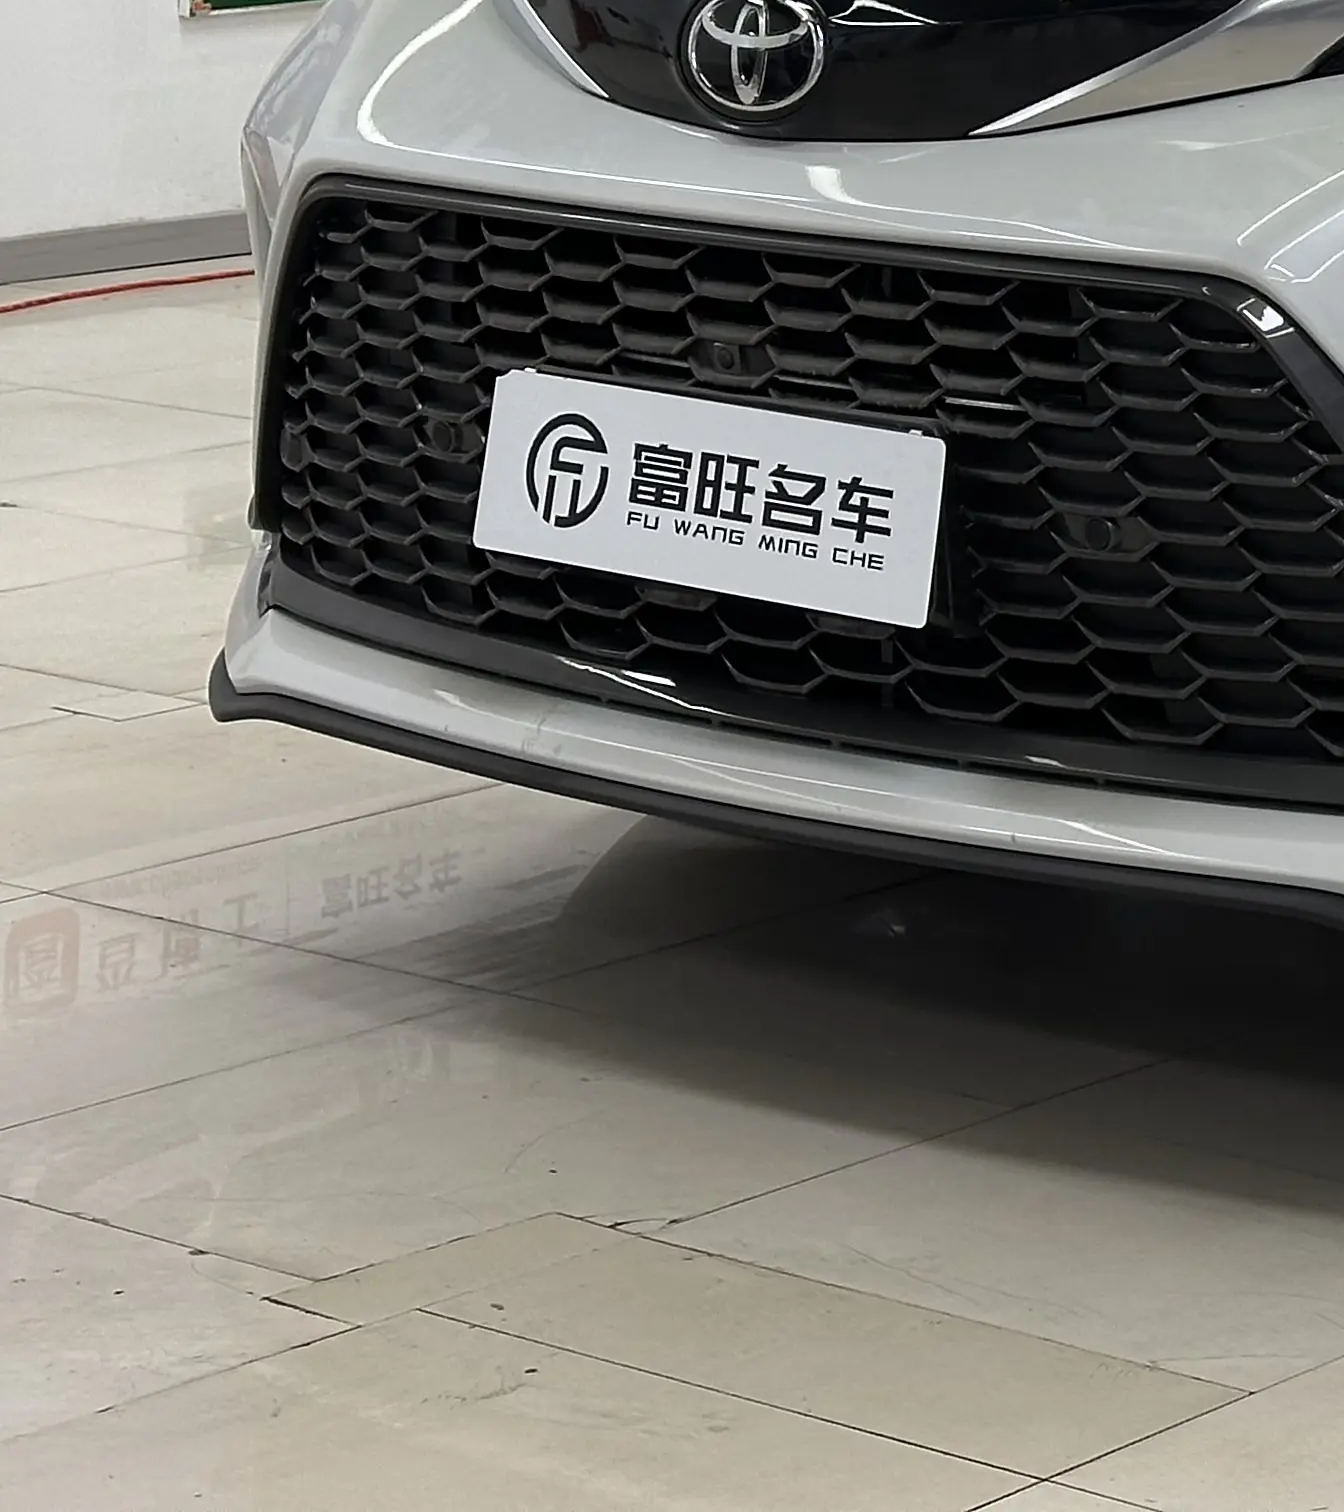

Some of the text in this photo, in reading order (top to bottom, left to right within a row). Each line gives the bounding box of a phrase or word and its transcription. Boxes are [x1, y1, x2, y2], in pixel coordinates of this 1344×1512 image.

[627, 442, 895, 544] 富旺名车
[626, 511, 886, 571] FU WANG MING CHE
